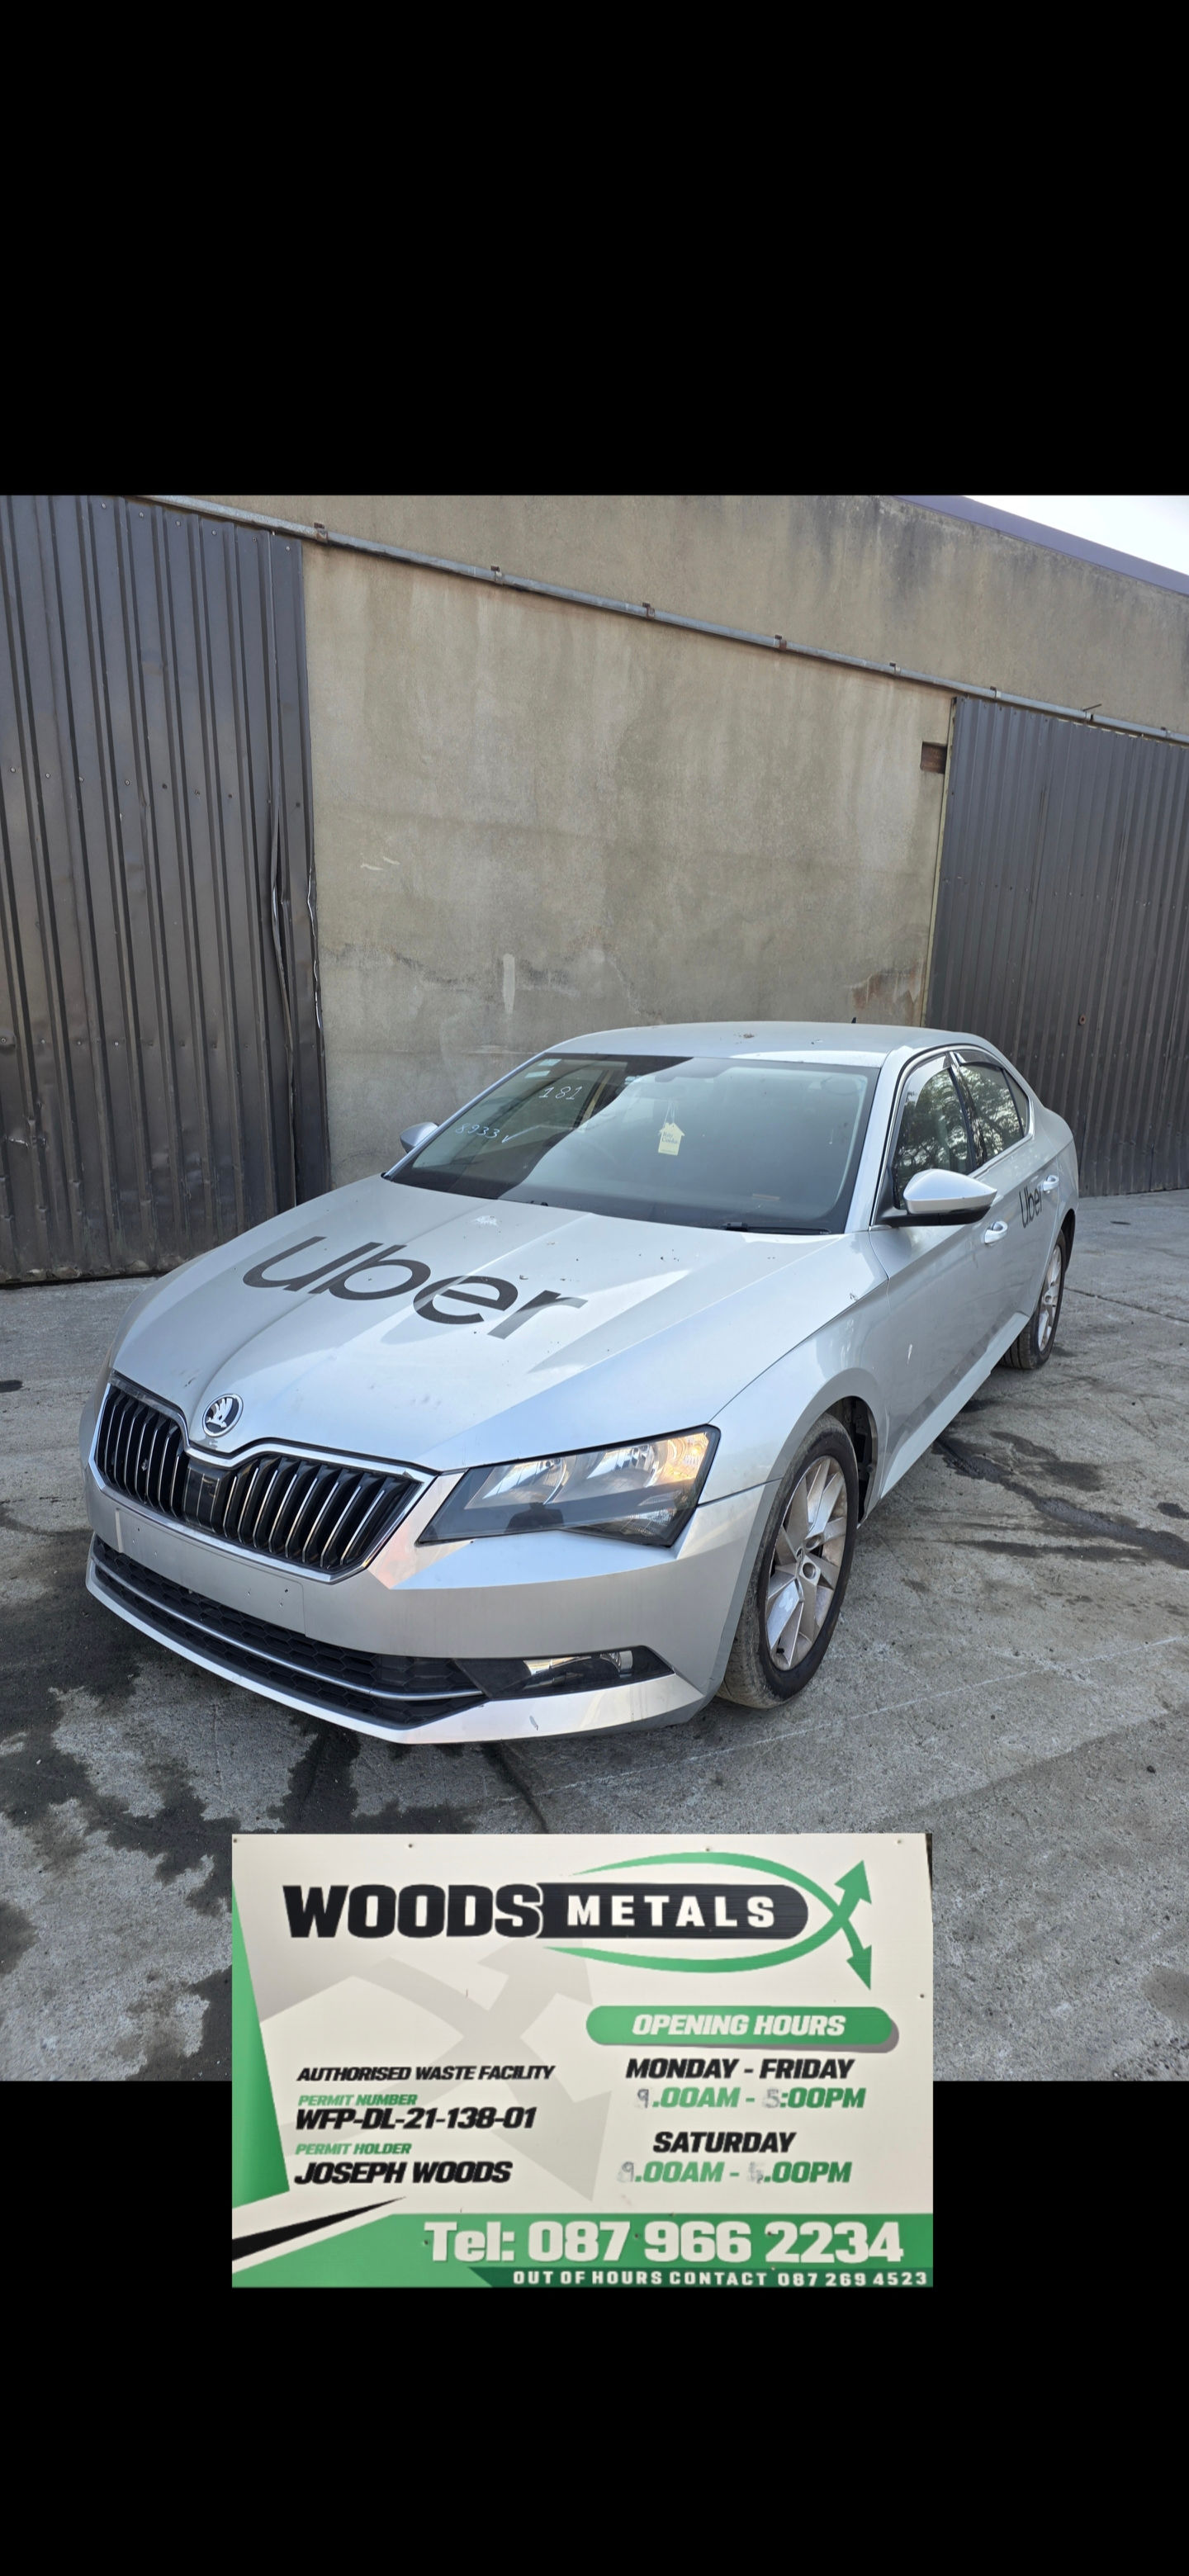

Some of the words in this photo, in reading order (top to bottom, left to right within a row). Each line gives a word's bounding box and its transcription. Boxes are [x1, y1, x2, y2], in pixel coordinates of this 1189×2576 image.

[539, 1086, 582, 1100] 181
[456, 1123, 501, 1139] 8933
[1019, 1185, 1042, 1229] Uber
